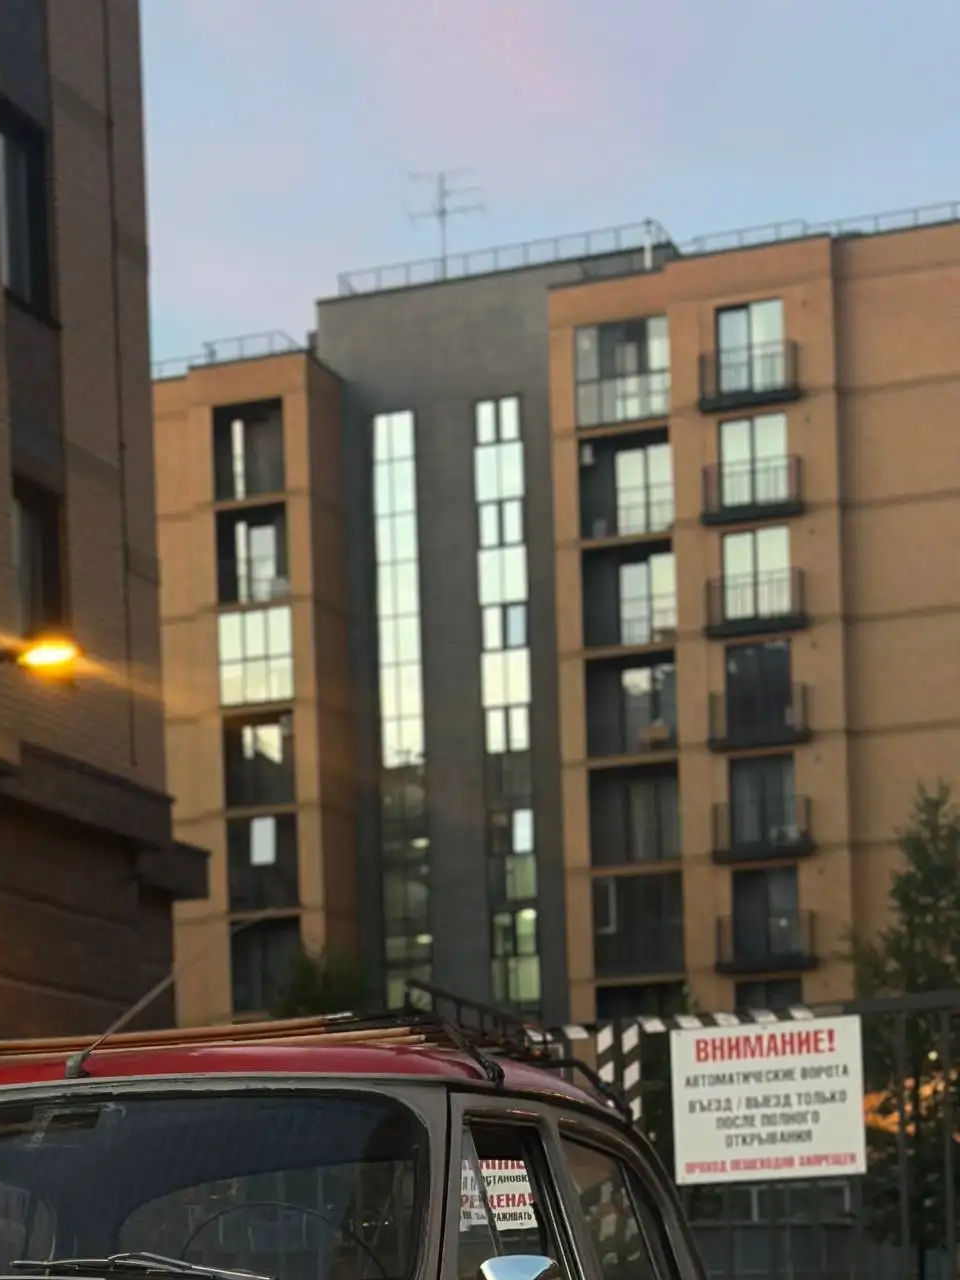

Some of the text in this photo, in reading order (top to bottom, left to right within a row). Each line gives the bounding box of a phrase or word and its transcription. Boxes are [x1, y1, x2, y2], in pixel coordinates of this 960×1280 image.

[695, 1028, 835, 1062] ВНИМАНИЕ!
[685, 1064, 849, 1088] АВТОМАТИЧЕСКИЕ ВОРОТА
[688, 1098, 732, 1113] ВЪЕЗД
[746, 1094, 791, 1110] ВЫЕЗД
[796, 1090, 847, 1105] ТОЛЬКО
[716, 1111, 820, 1129] ПОСЛЕ ПОЛНОГО
[725, 1129, 812, 1148] ОТКРЫВАНИЯ
